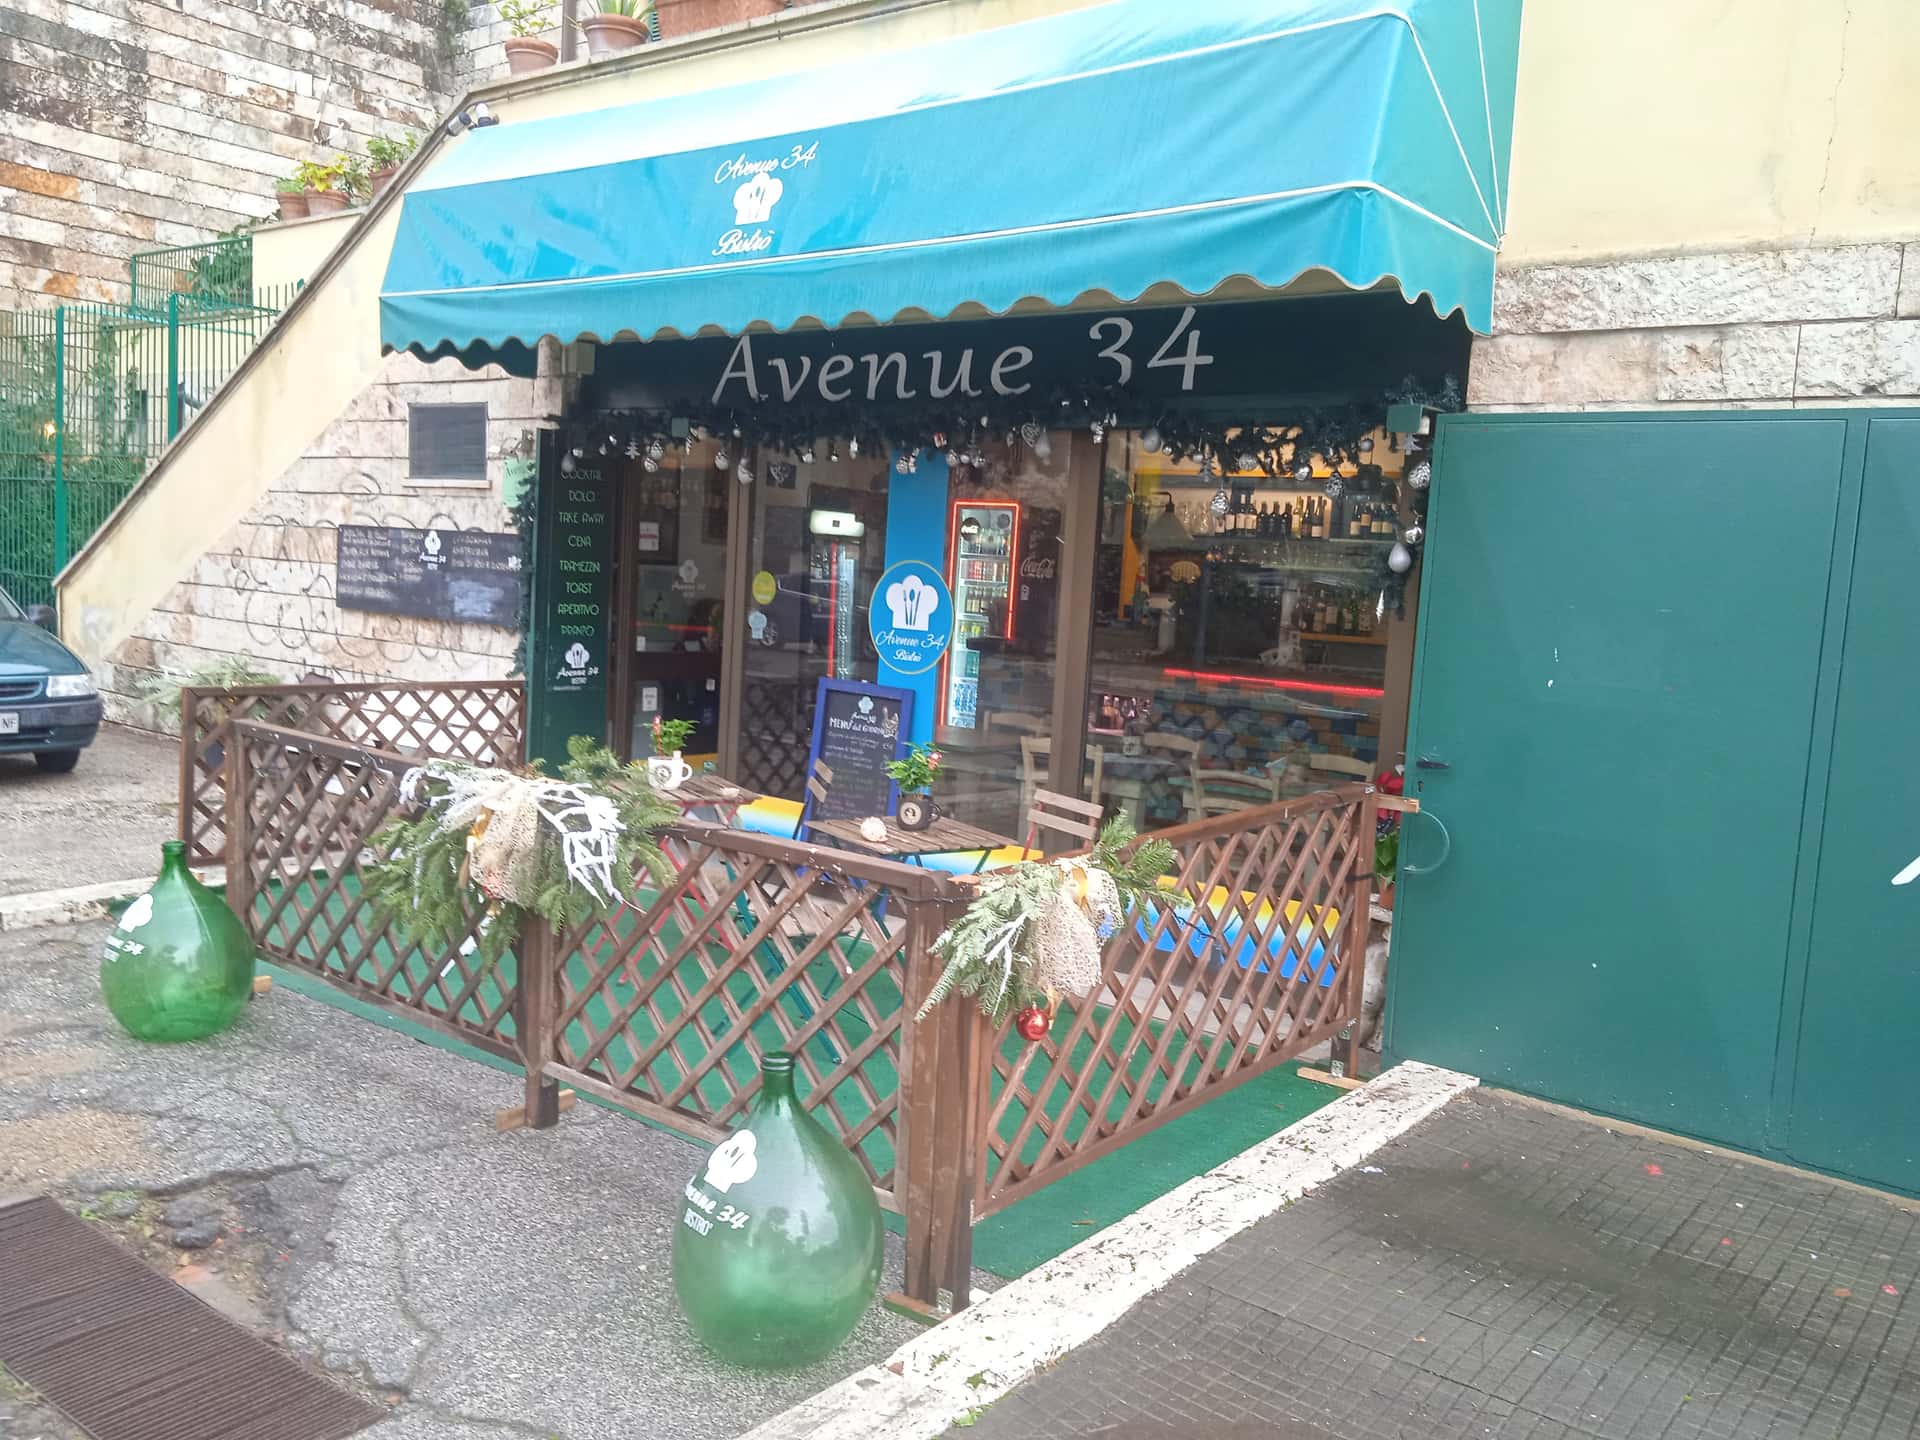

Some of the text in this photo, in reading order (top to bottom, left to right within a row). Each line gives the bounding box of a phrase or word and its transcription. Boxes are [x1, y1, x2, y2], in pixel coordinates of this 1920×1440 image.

[714, 140, 820, 184] Avenue 34
[712, 305, 1214, 403] Avenue 34
[559, 511, 606, 525] TAKE AWAY
[567, 535, 592, 548] CENA
[565, 582, 592, 594] TOAST
[875, 629, 945, 651] Avenue 34
[716, 1204, 750, 1230] 34
